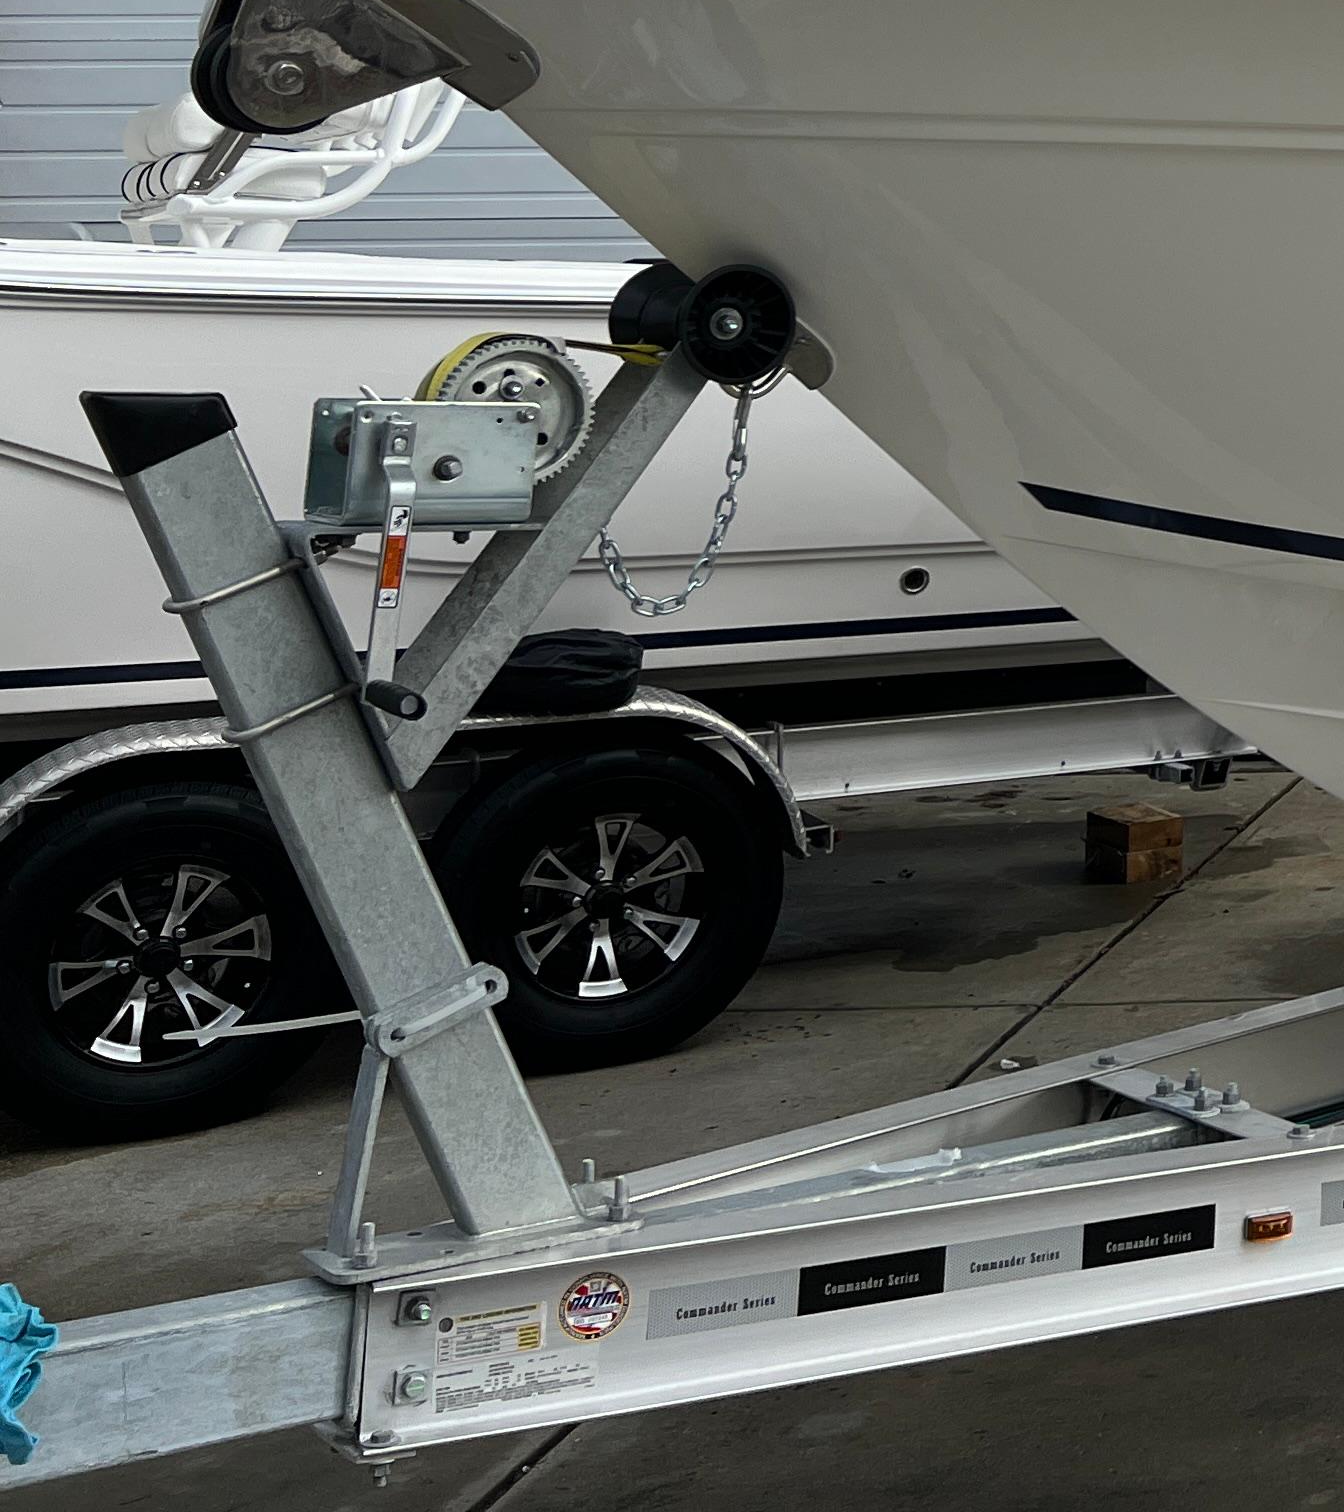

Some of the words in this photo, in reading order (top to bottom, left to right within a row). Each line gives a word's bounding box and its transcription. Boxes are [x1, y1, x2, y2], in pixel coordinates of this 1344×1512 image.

[1106, 1235, 1160, 1253] Commander
[1163, 1231, 1192, 1245] Series
[970, 1255, 1026, 1273] Commander
[1030, 1251, 1060, 1263] Series
[824, 1276, 884, 1295] Commander
[888, 1272, 920, 1286] Series
[676, 1301, 738, 1320] Commander
[742, 1295, 776, 1310] Series
